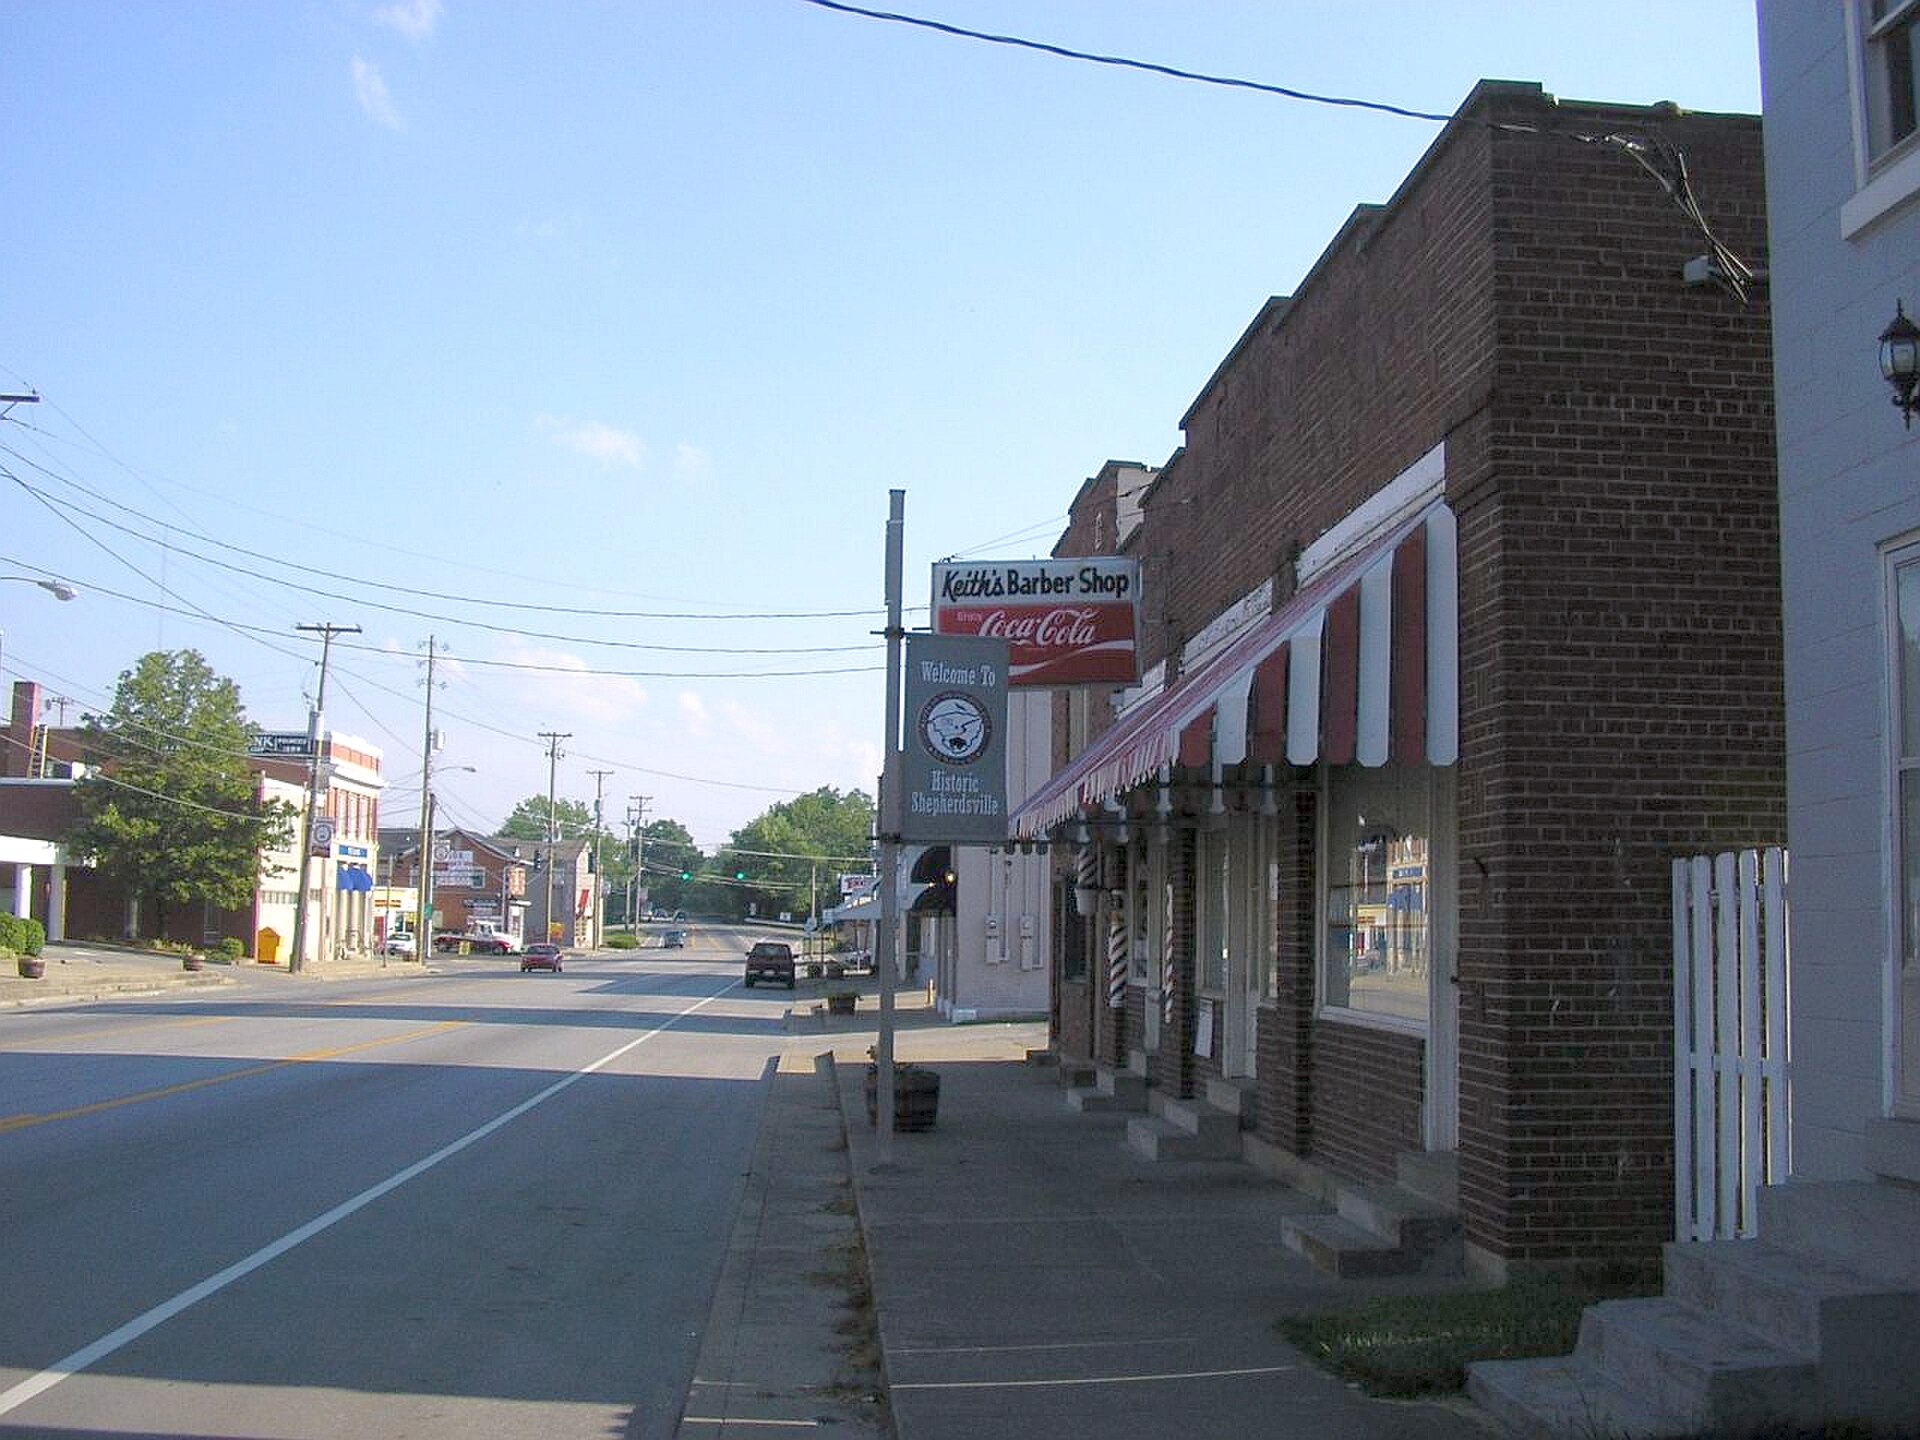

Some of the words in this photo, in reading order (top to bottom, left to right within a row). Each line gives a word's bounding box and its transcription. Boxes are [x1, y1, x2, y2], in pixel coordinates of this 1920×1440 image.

[1007, 568, 1075, 596] Barber
[1079, 567, 1130, 599] Shop
[921, 660, 976, 685] Welcome
[980, 664, 996, 686] To
[931, 770, 979, 793] Historic
[911, 791, 998, 817] Shepherdsville
